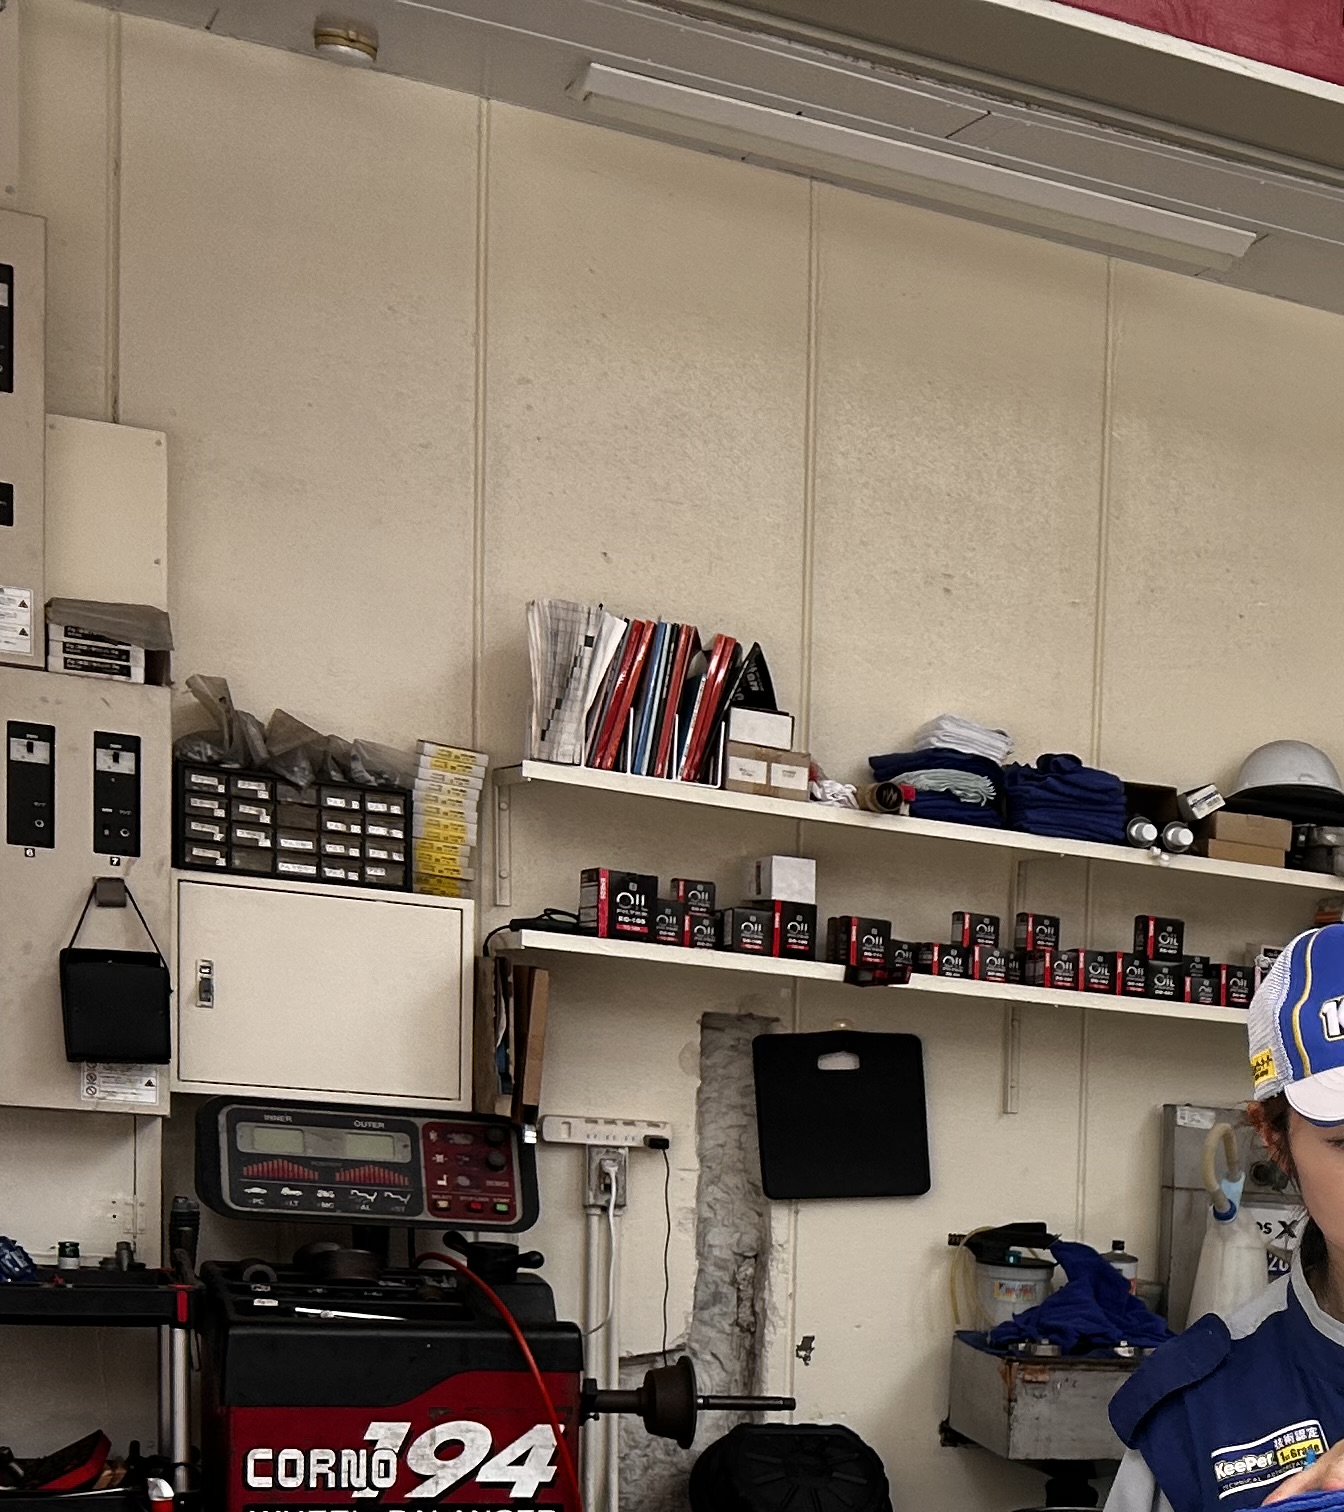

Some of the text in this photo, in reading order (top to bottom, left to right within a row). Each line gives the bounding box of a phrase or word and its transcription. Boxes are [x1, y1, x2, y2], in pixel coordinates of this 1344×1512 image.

[264, 1114, 385, 1129] INNER OUTER
[246, 1420, 566, 1498] CORNO 194
[1214, 1450, 1275, 1482] KeePer
